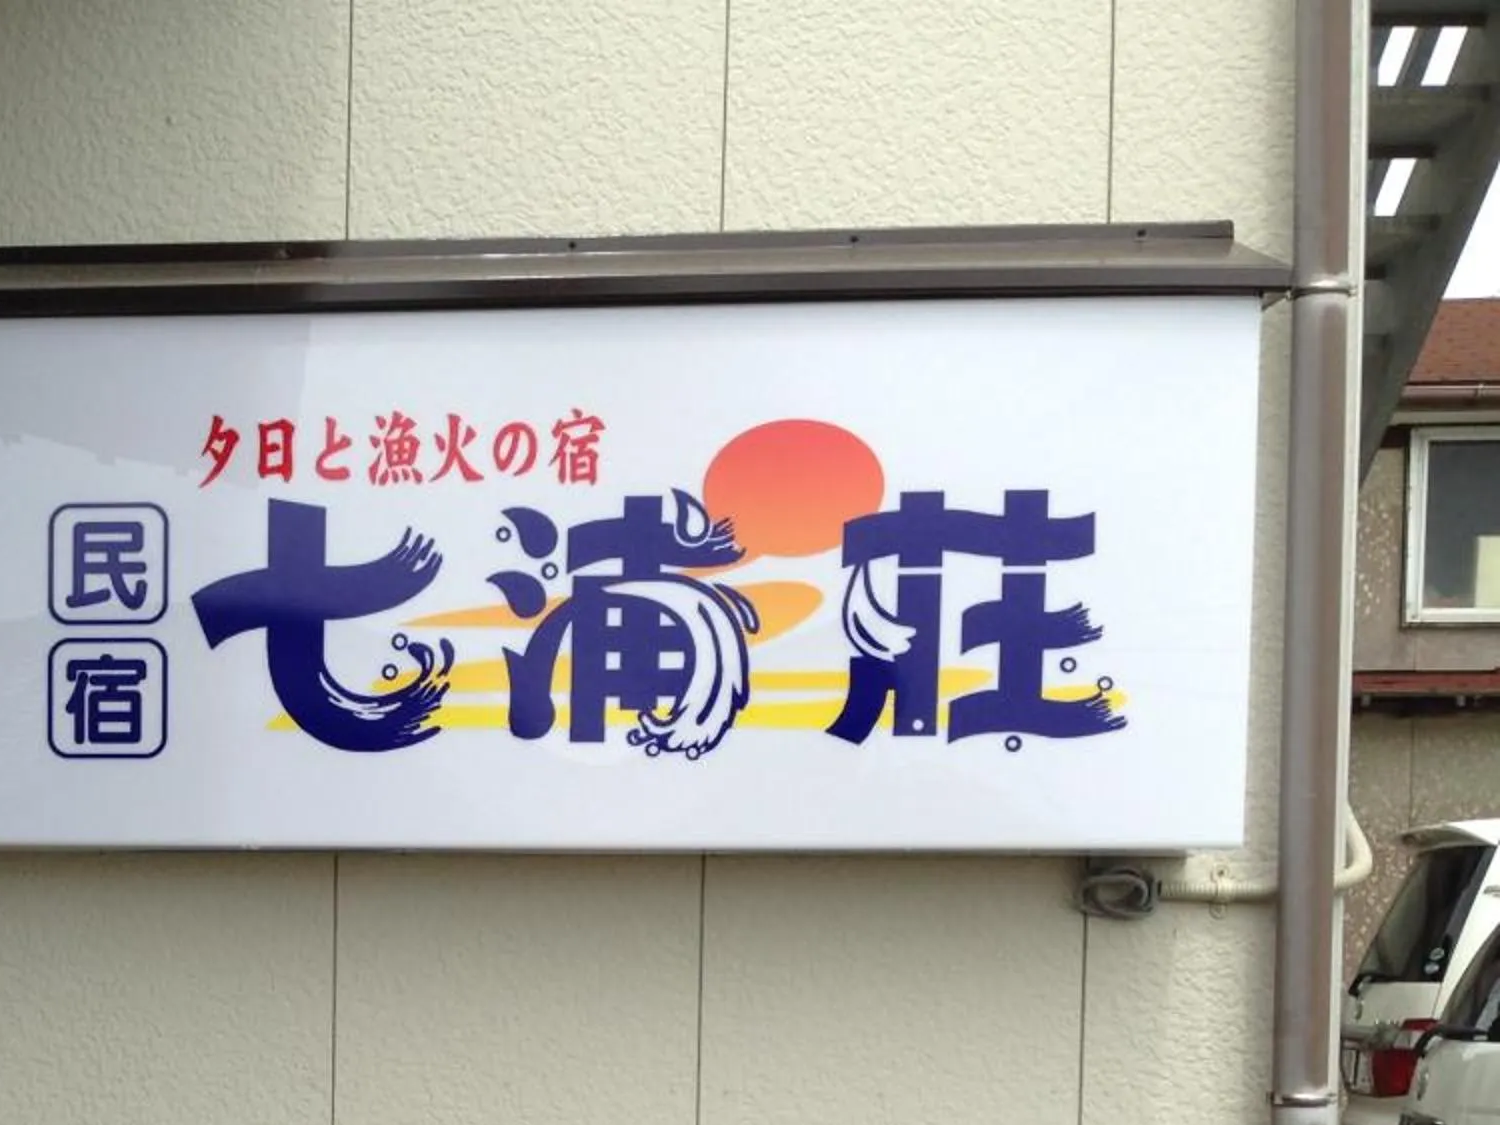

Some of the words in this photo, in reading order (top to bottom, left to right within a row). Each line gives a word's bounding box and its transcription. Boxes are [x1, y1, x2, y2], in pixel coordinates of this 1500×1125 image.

[199, 408, 606, 487] 夕日と漁火の宿
[191, 489, 1128, 758] 七浦荘
